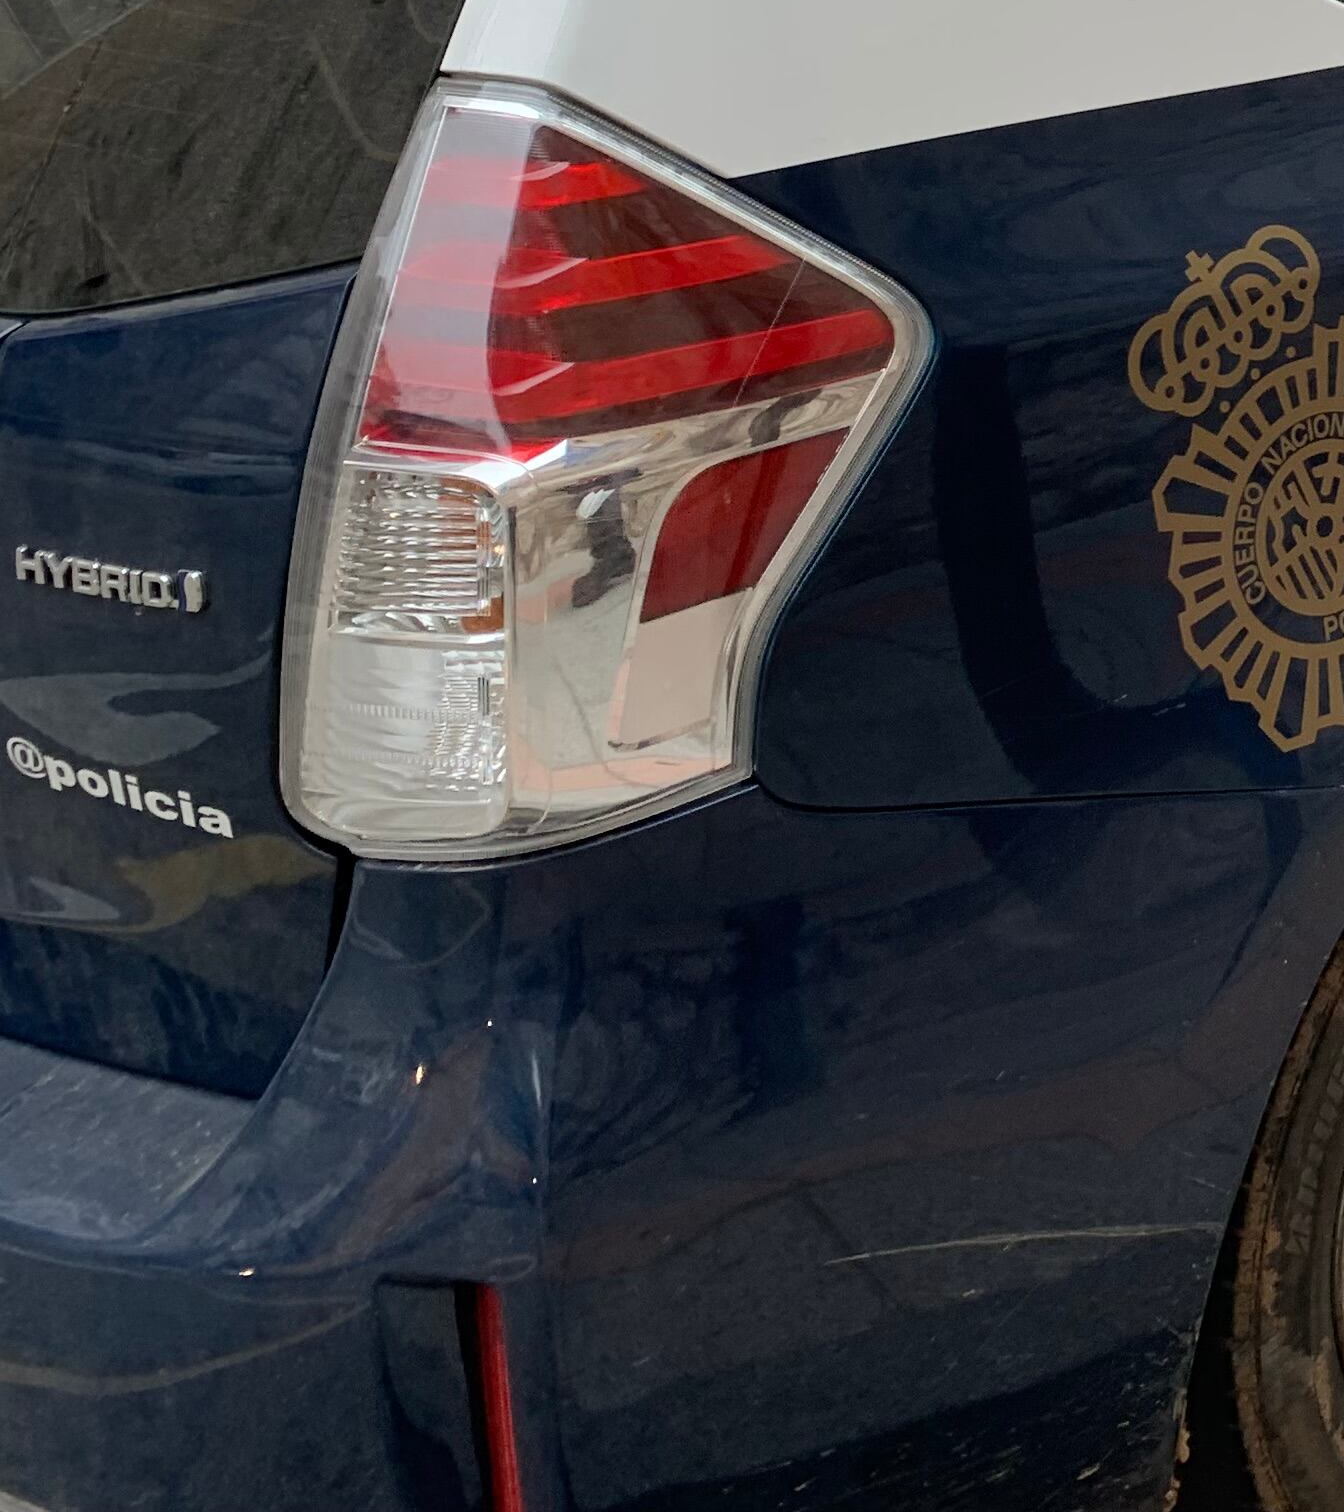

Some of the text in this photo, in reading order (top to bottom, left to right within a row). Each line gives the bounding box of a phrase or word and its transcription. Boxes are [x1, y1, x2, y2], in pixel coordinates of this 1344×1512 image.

[15, 543, 174, 609] HYBRID
[1234, 481, 1266, 605] CUERPO
[5, 736, 234, 839] @policia
